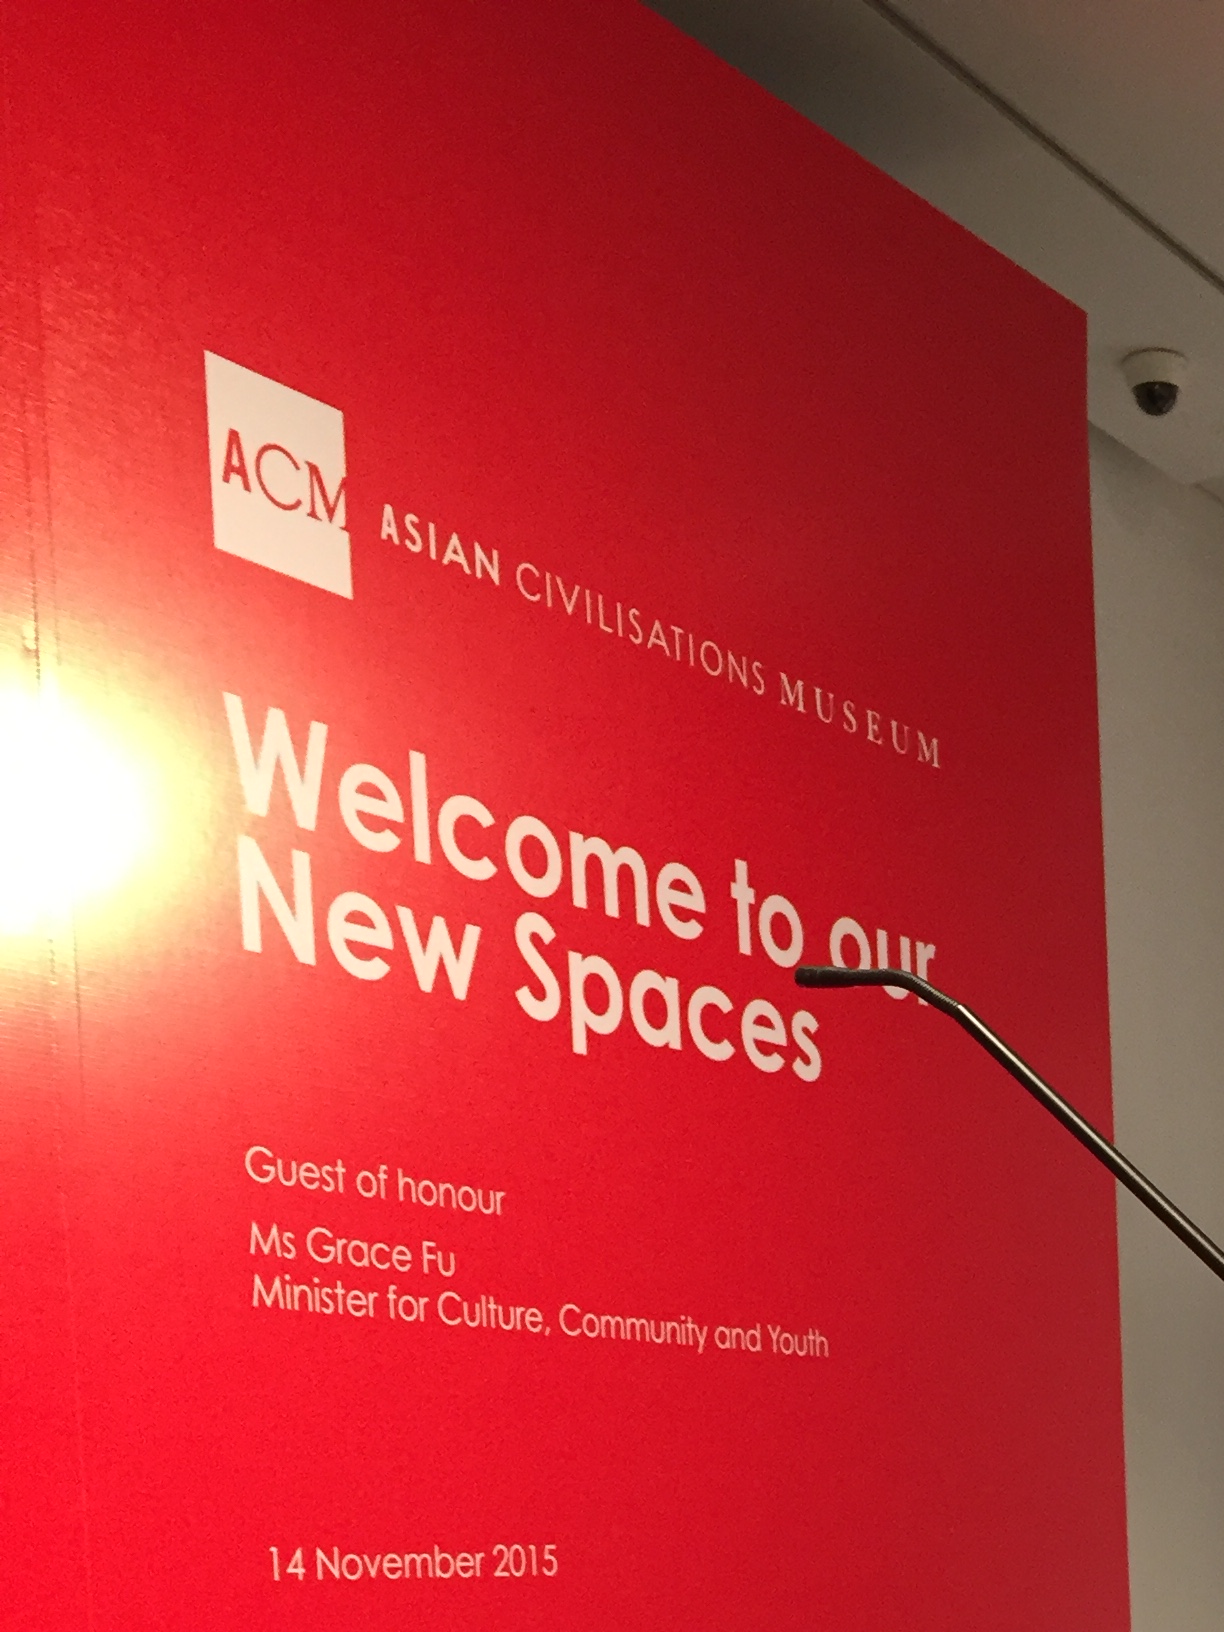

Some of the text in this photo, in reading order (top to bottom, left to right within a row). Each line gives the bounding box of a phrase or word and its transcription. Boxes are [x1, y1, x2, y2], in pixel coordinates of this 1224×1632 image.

[222, 428, 350, 533] ACM
[380, 503, 942, 769] ASIAN CIVILISATIONS MUSEUM
[222, 691, 936, 1006] Welcome to our
[237, 835, 822, 1082] New Spaces
[244, 1145, 506, 1216] Guest of honour
[249, 1221, 456, 1277] Ms Grace Fu
[252, 1273, 830, 1358] Minister for Culture, Community and Youth
[268, 1543, 559, 1581] 14 November 2015
